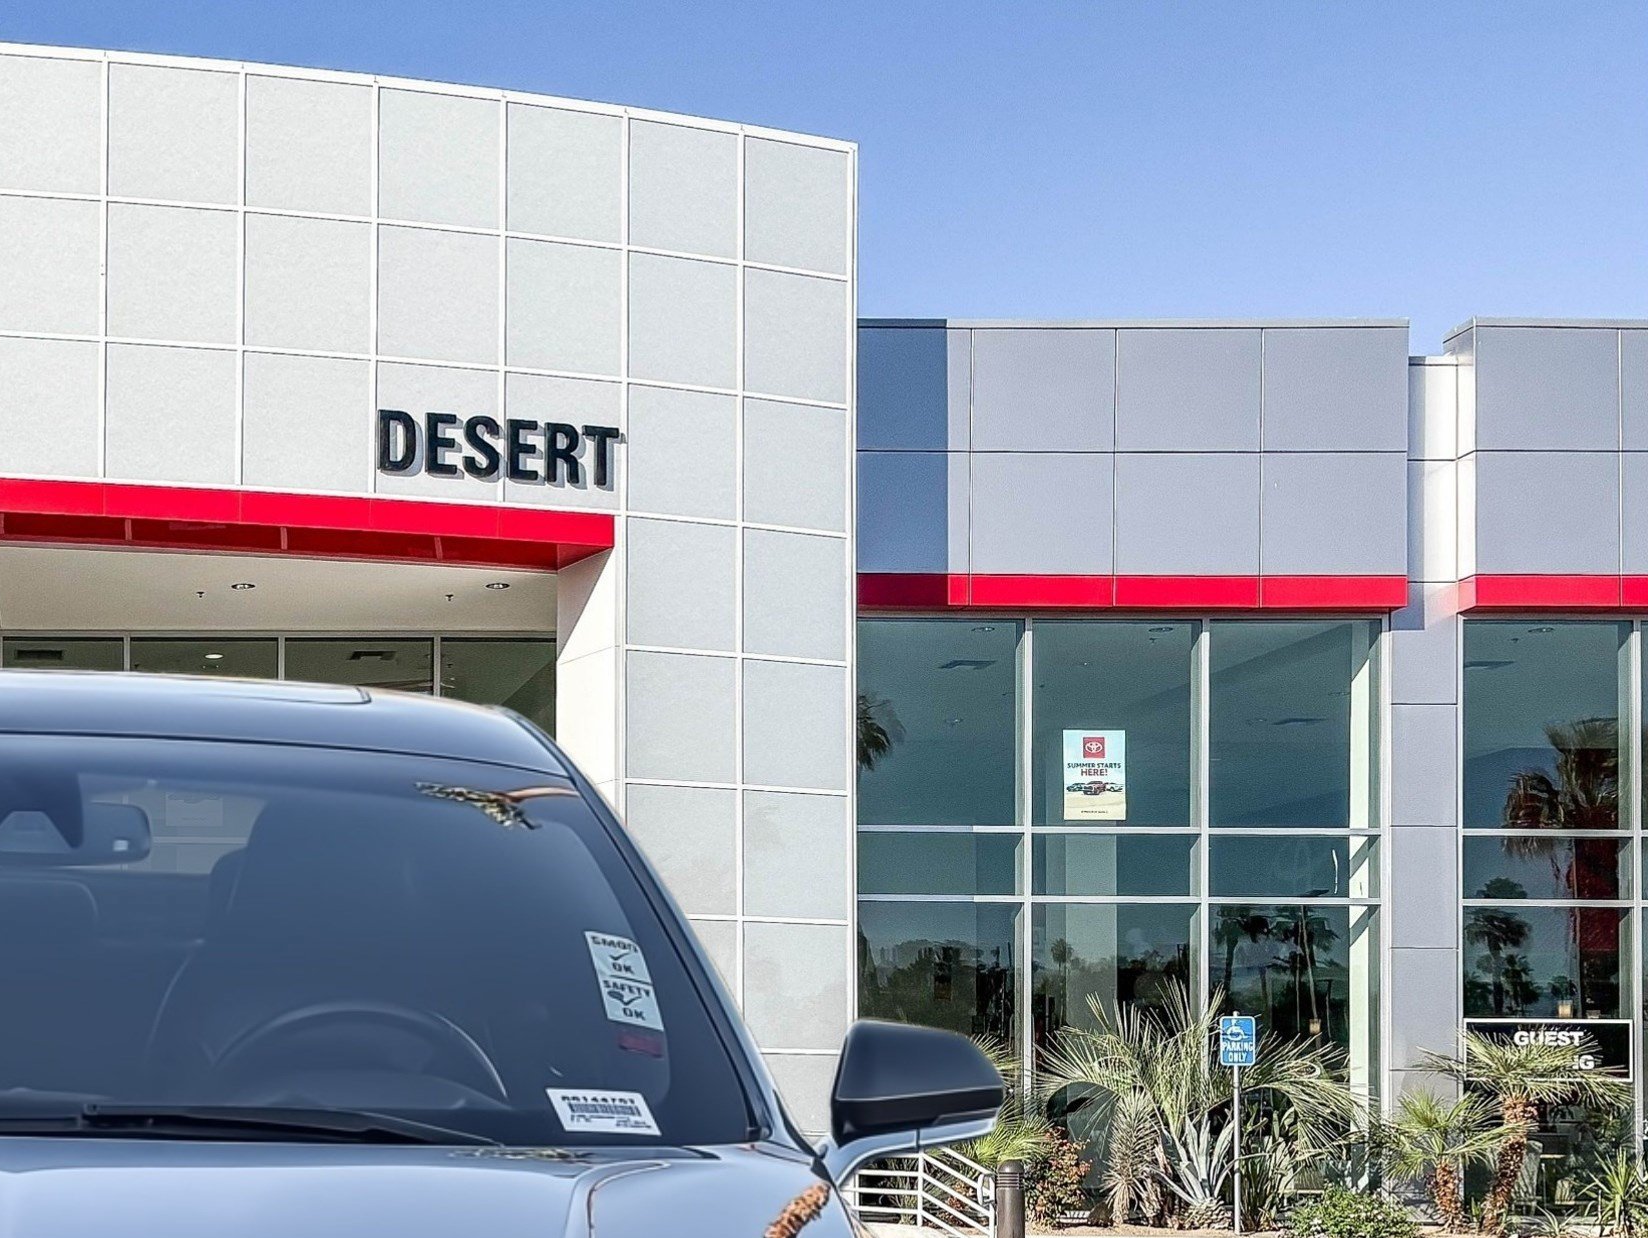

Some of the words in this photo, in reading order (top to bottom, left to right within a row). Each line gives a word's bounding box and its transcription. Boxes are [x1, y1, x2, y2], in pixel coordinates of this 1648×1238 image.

[377, 409, 620, 486] DESERT
[1080, 768, 1108, 777] HERE!
[612, 962, 635, 975] OK
[603, 980, 651, 998] SAFETY
[622, 1007, 647, 1021] OK
[1513, 1030, 1584, 1047] GUEST
[1222, 1041, 1254, 1051] PARKING
[1228, 1052, 1248, 1062] ONLY
